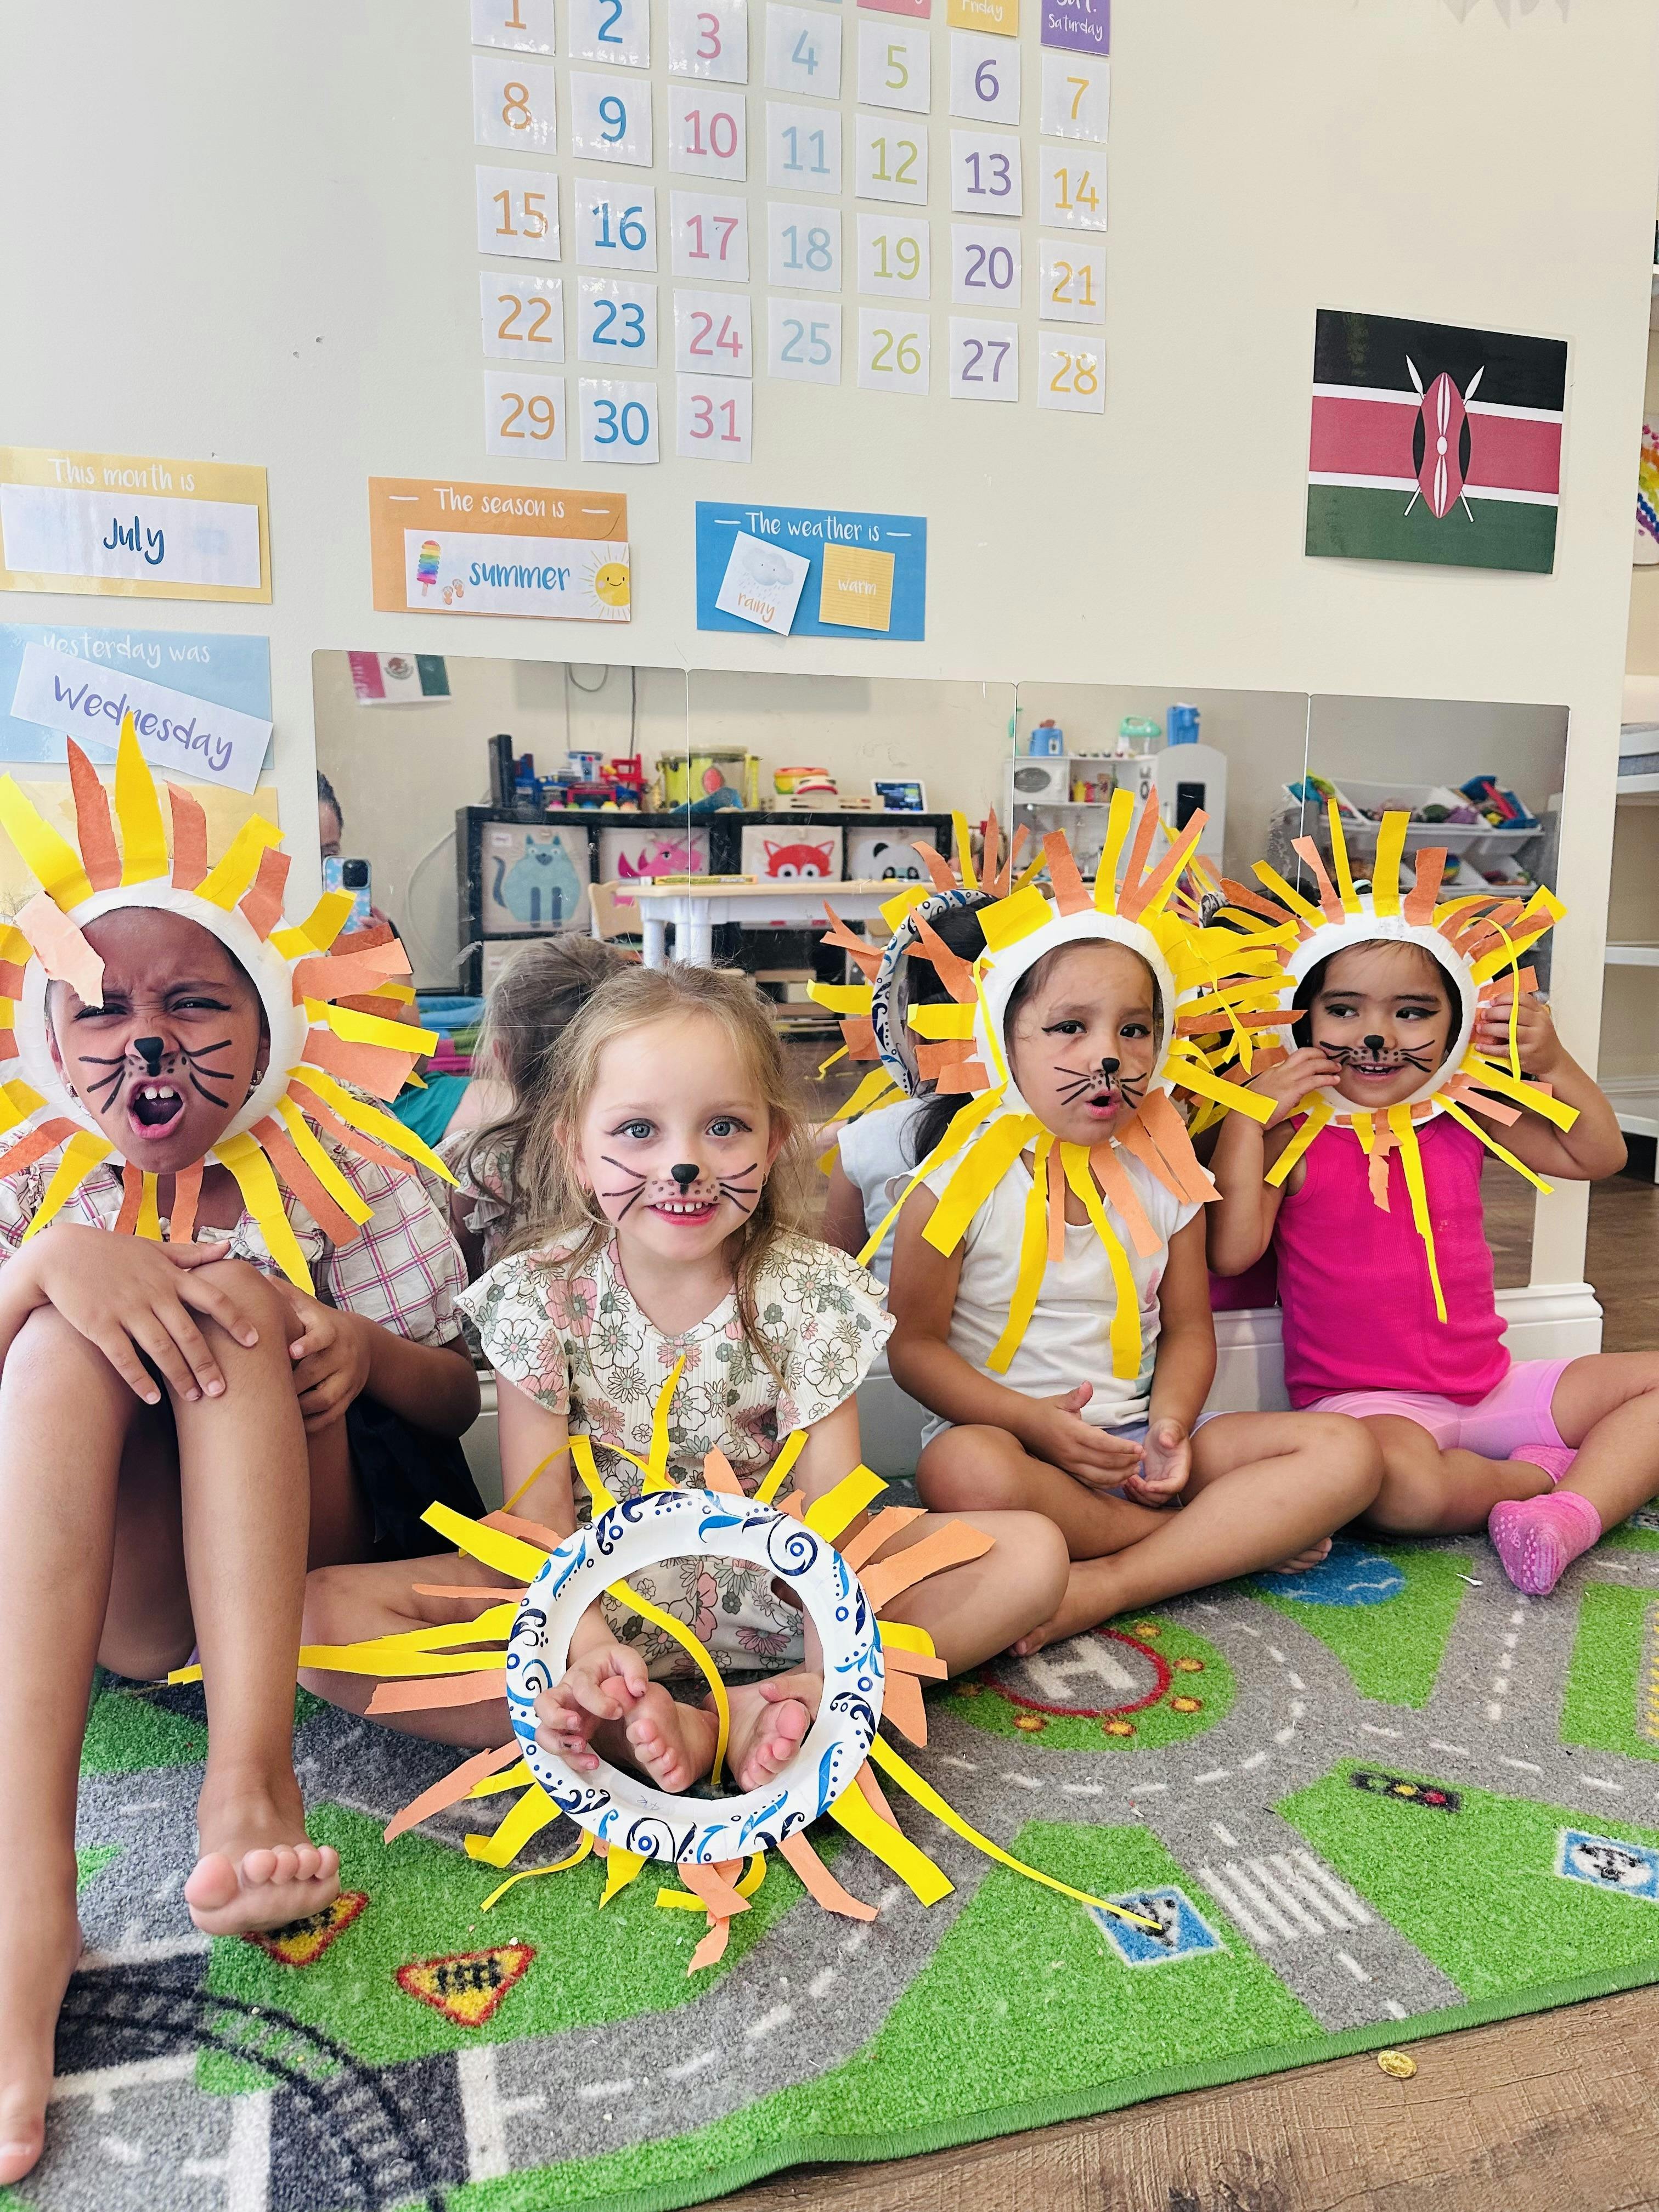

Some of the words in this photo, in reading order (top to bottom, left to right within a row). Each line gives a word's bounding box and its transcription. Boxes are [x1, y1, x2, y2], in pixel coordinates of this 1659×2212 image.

[505, 0, 527, 30] 1
[598, 0, 623, 43] 2
[962, 0, 1003, 21] Friday
[1048, 14, 1103, 41] Saturday
[696, 13, 721, 59] 3
[792, 29, 818, 75] 4
[884, 44, 909, 89] 5
[974, 59, 1000, 101] 6
[502, 82, 532, 129] 8
[599, 96, 627, 142] 9
[1066, 77, 1090, 120] 7
[684, 110, 738, 158] 10
[781, 126, 830, 174] 11
[871, 137, 918, 185] 12
[964, 152, 1012, 196] 13
[1053, 168, 1099, 212] 14
[493, 190, 549, 239] 15
[592, 202, 647, 251] 16
[686, 215, 738, 261] 17
[781, 225, 833, 272] 18
[871, 235, 920, 280] 19
[964, 244, 1013, 289] 20
[1052, 261, 1096, 306] 21
[497, 295, 553, 343] 22
[592, 299, 646, 348] 23
[690, 311, 743, 358] 24
[781, 319, 832, 365] 25
[871, 329, 922, 375] 26
[962, 338, 1011, 382] 27
[1050, 351, 1098, 395] 28
[500, 392, 555, 440] 29
[593, 399, 650, 445] 30
[689, 394, 741, 442] 31
[48, 456, 95, 486] This
[103, 464, 172, 490] month
[180, 473, 195, 492] is
[433, 487, 473, 512] The
[481, 494, 545, 517] season
[551, 500, 565, 518] is
[103, 515, 164, 565] July
[745, 511, 781, 535] The
[787, 516, 862, 541] weather
[868, 525, 880, 541] is
[469, 561, 570, 591] summer
[838, 578, 877, 596] warm
[737, 591, 775, 623] rainy
[169, 645, 210, 663] was
[54, 675, 233, 771] Wednesday
